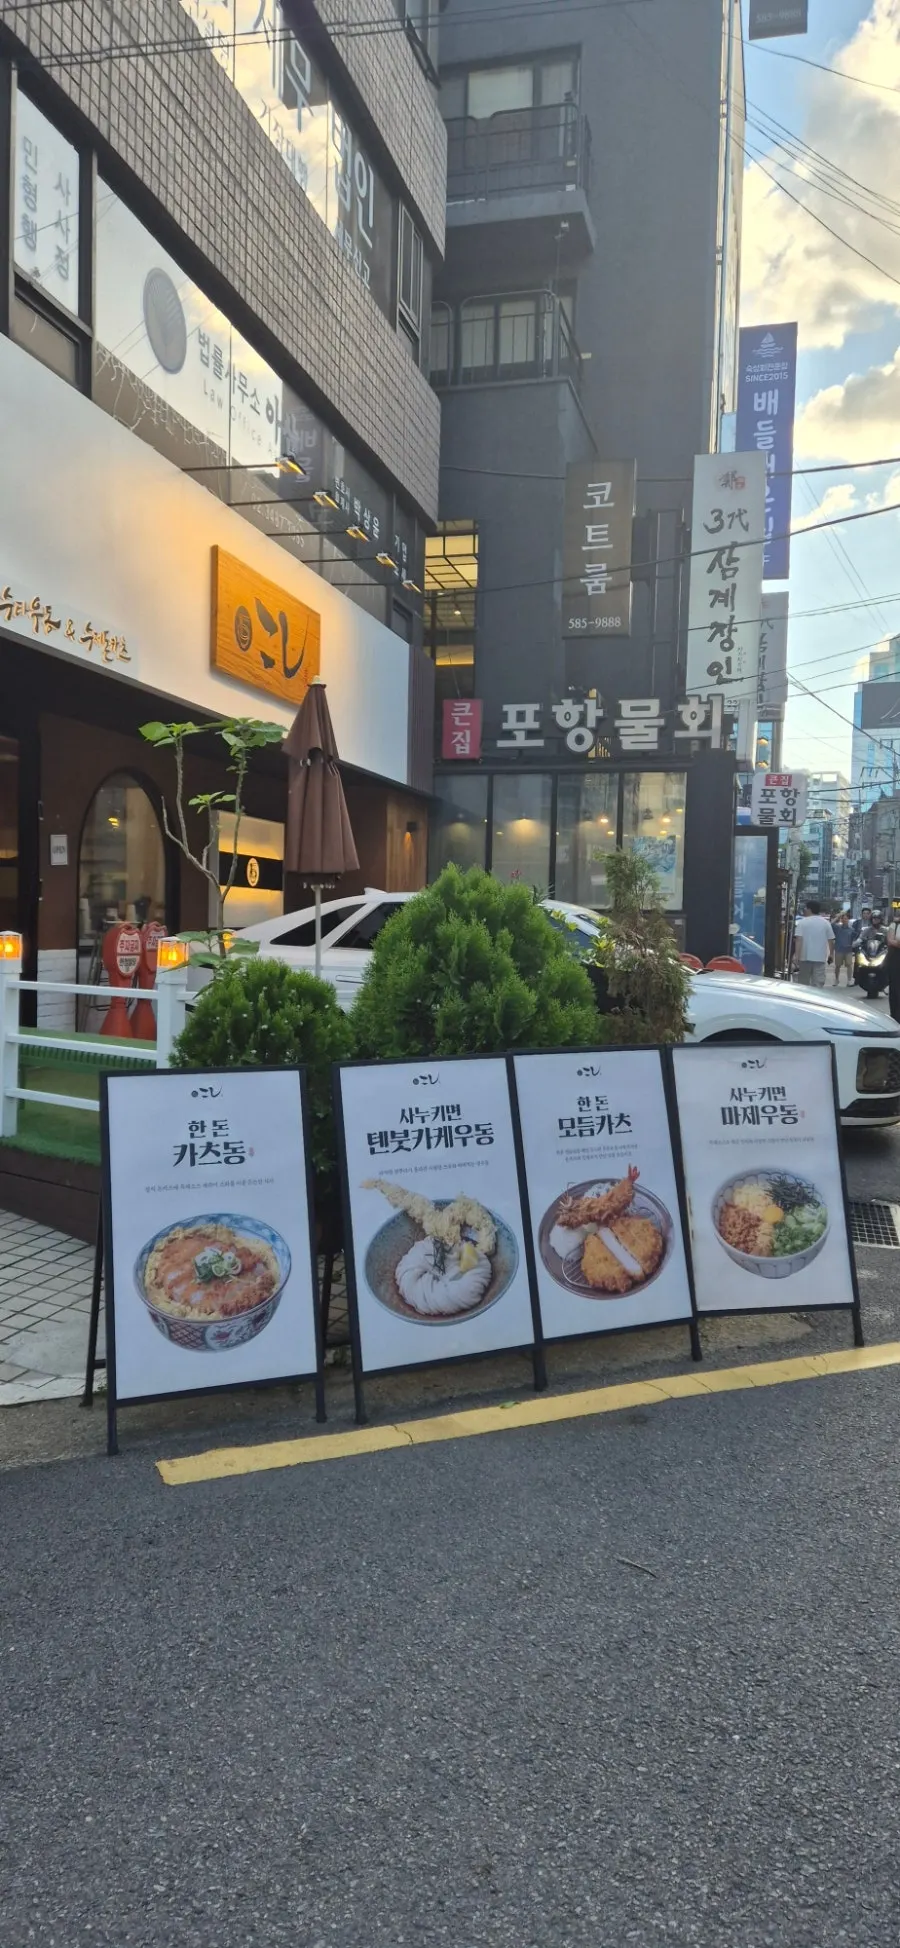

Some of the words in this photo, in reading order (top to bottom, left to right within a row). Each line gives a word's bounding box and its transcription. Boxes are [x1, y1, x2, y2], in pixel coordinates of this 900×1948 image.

[579, 481, 616, 596] 코트룸
[568, 616, 622, 629] 585-9888
[705, 541, 743, 686] 삼계장인
[450, 702, 475, 756] 큰집
[496, 694, 725, 754] 포항물회
[768, 775, 789, 786] 큰집
[757, 788, 801, 806] 포항
[757, 807, 798, 826] 물회
[729, 1086, 787, 1103] 사누키면
[399, 1104, 462, 1125] 사누키면
[558, 1113, 633, 1138] 모듬카츠
[721, 1104, 799, 1126] 마제우동
[366, 1122, 495, 1155] 텐붓카케우동
[172, 1141, 247, 1168] 카츠동
